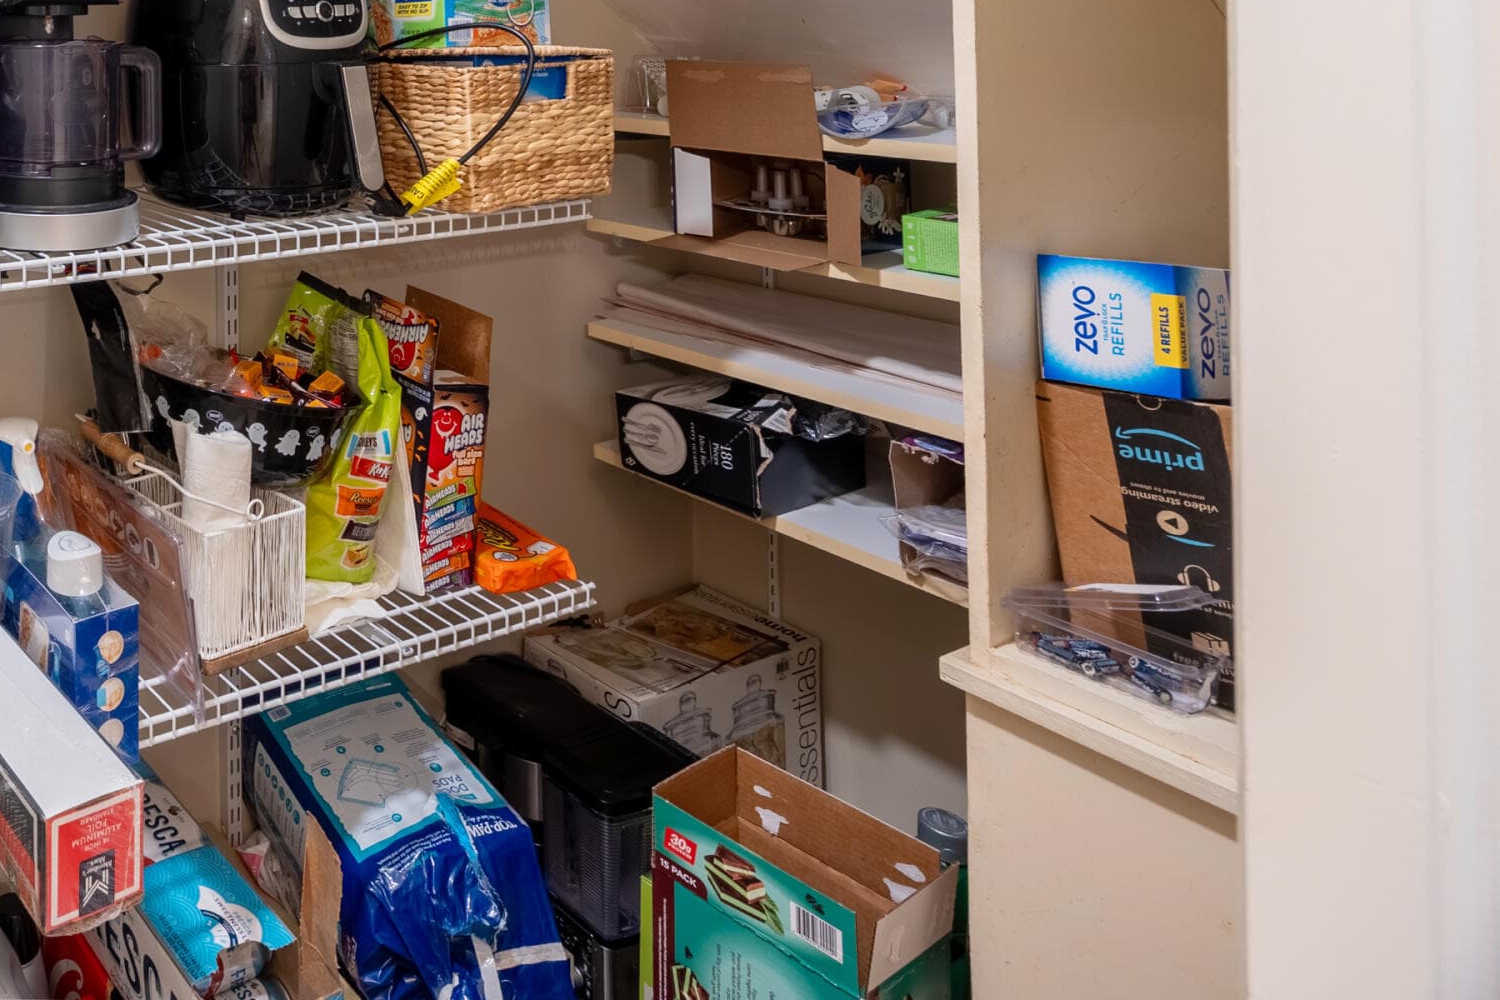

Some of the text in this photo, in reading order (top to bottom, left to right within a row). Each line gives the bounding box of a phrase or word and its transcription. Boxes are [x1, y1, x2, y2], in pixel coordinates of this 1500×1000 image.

[1072, 285, 1099, 355] zevo
[1109, 292, 1125, 357] REFILLS
[1158, 306, 1170, 346] REFILLS
[1178, 300, 1188, 363] VALUE PACK
[1197, 287, 1216, 380] zevo
[461, 413, 484, 433] AIR
[444, 430, 484, 454] HEADS
[719, 444, 733, 471] 180
[1119, 443, 1205, 472] prime
[1121, 485, 1220, 515] video streaming
[431, 773, 462, 789] PADS
[71, 822, 122, 848] ALUMINUM
[87, 820, 108, 833] FOIL
[669, 833, 693, 852] 30g
[659, 857, 698, 889] 15 PACK
